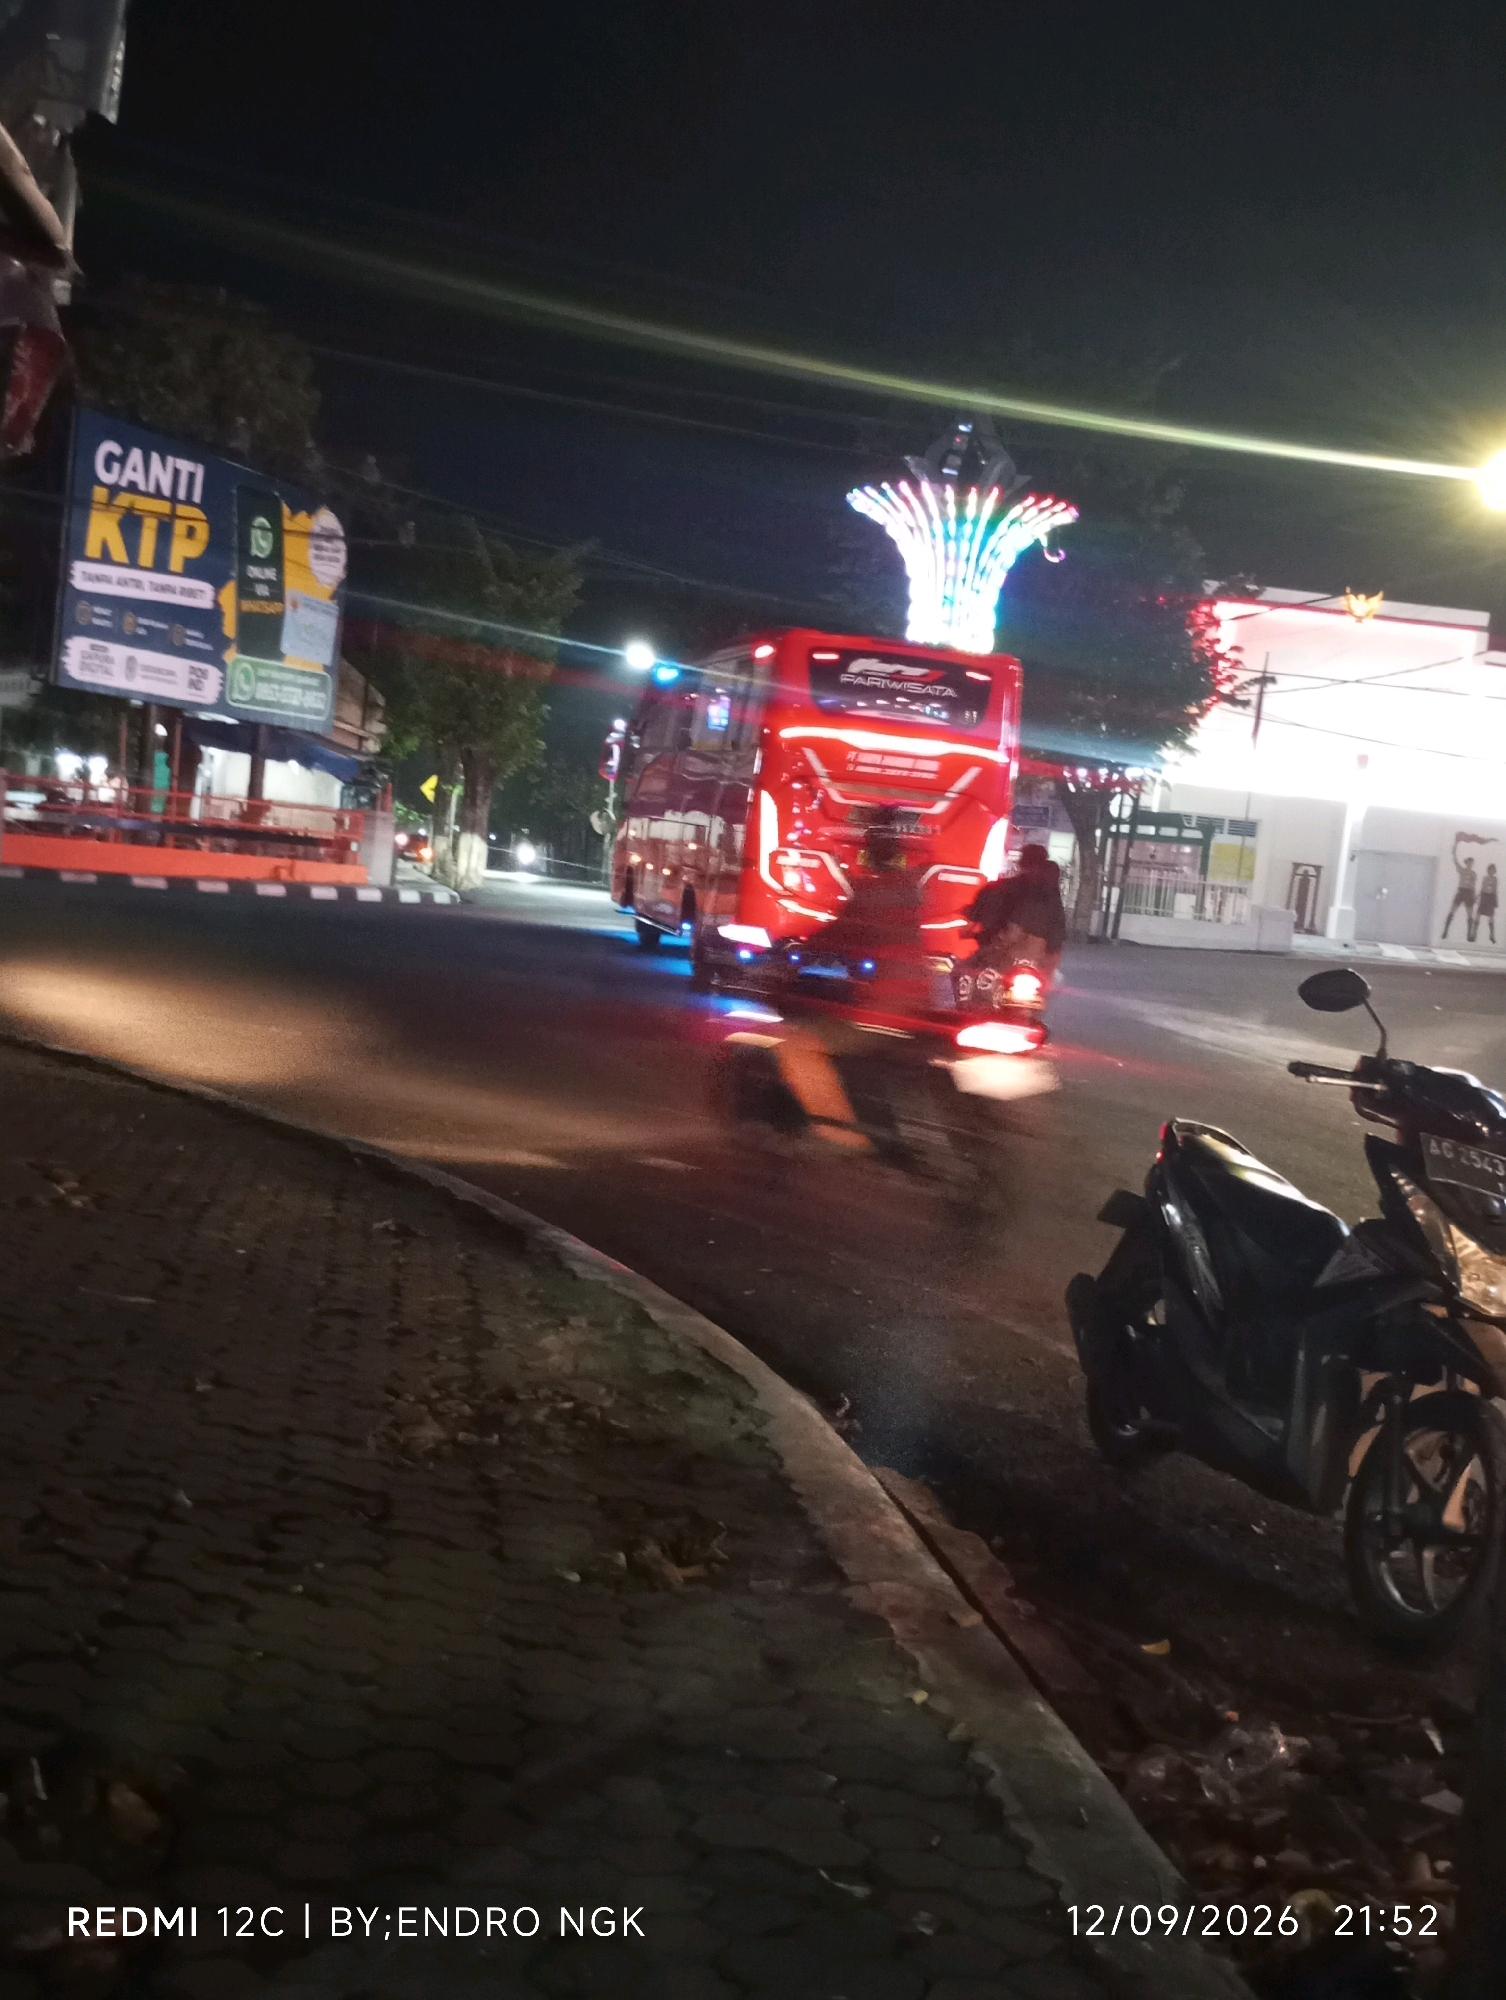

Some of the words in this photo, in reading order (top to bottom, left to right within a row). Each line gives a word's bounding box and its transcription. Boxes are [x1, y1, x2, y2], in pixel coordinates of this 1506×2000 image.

[94, 440, 205, 503] GANTI
[84, 485, 210, 574] KTP
[840, 673, 958, 698] PARIWISATA
[1430, 1139, 1455, 1159] AG
